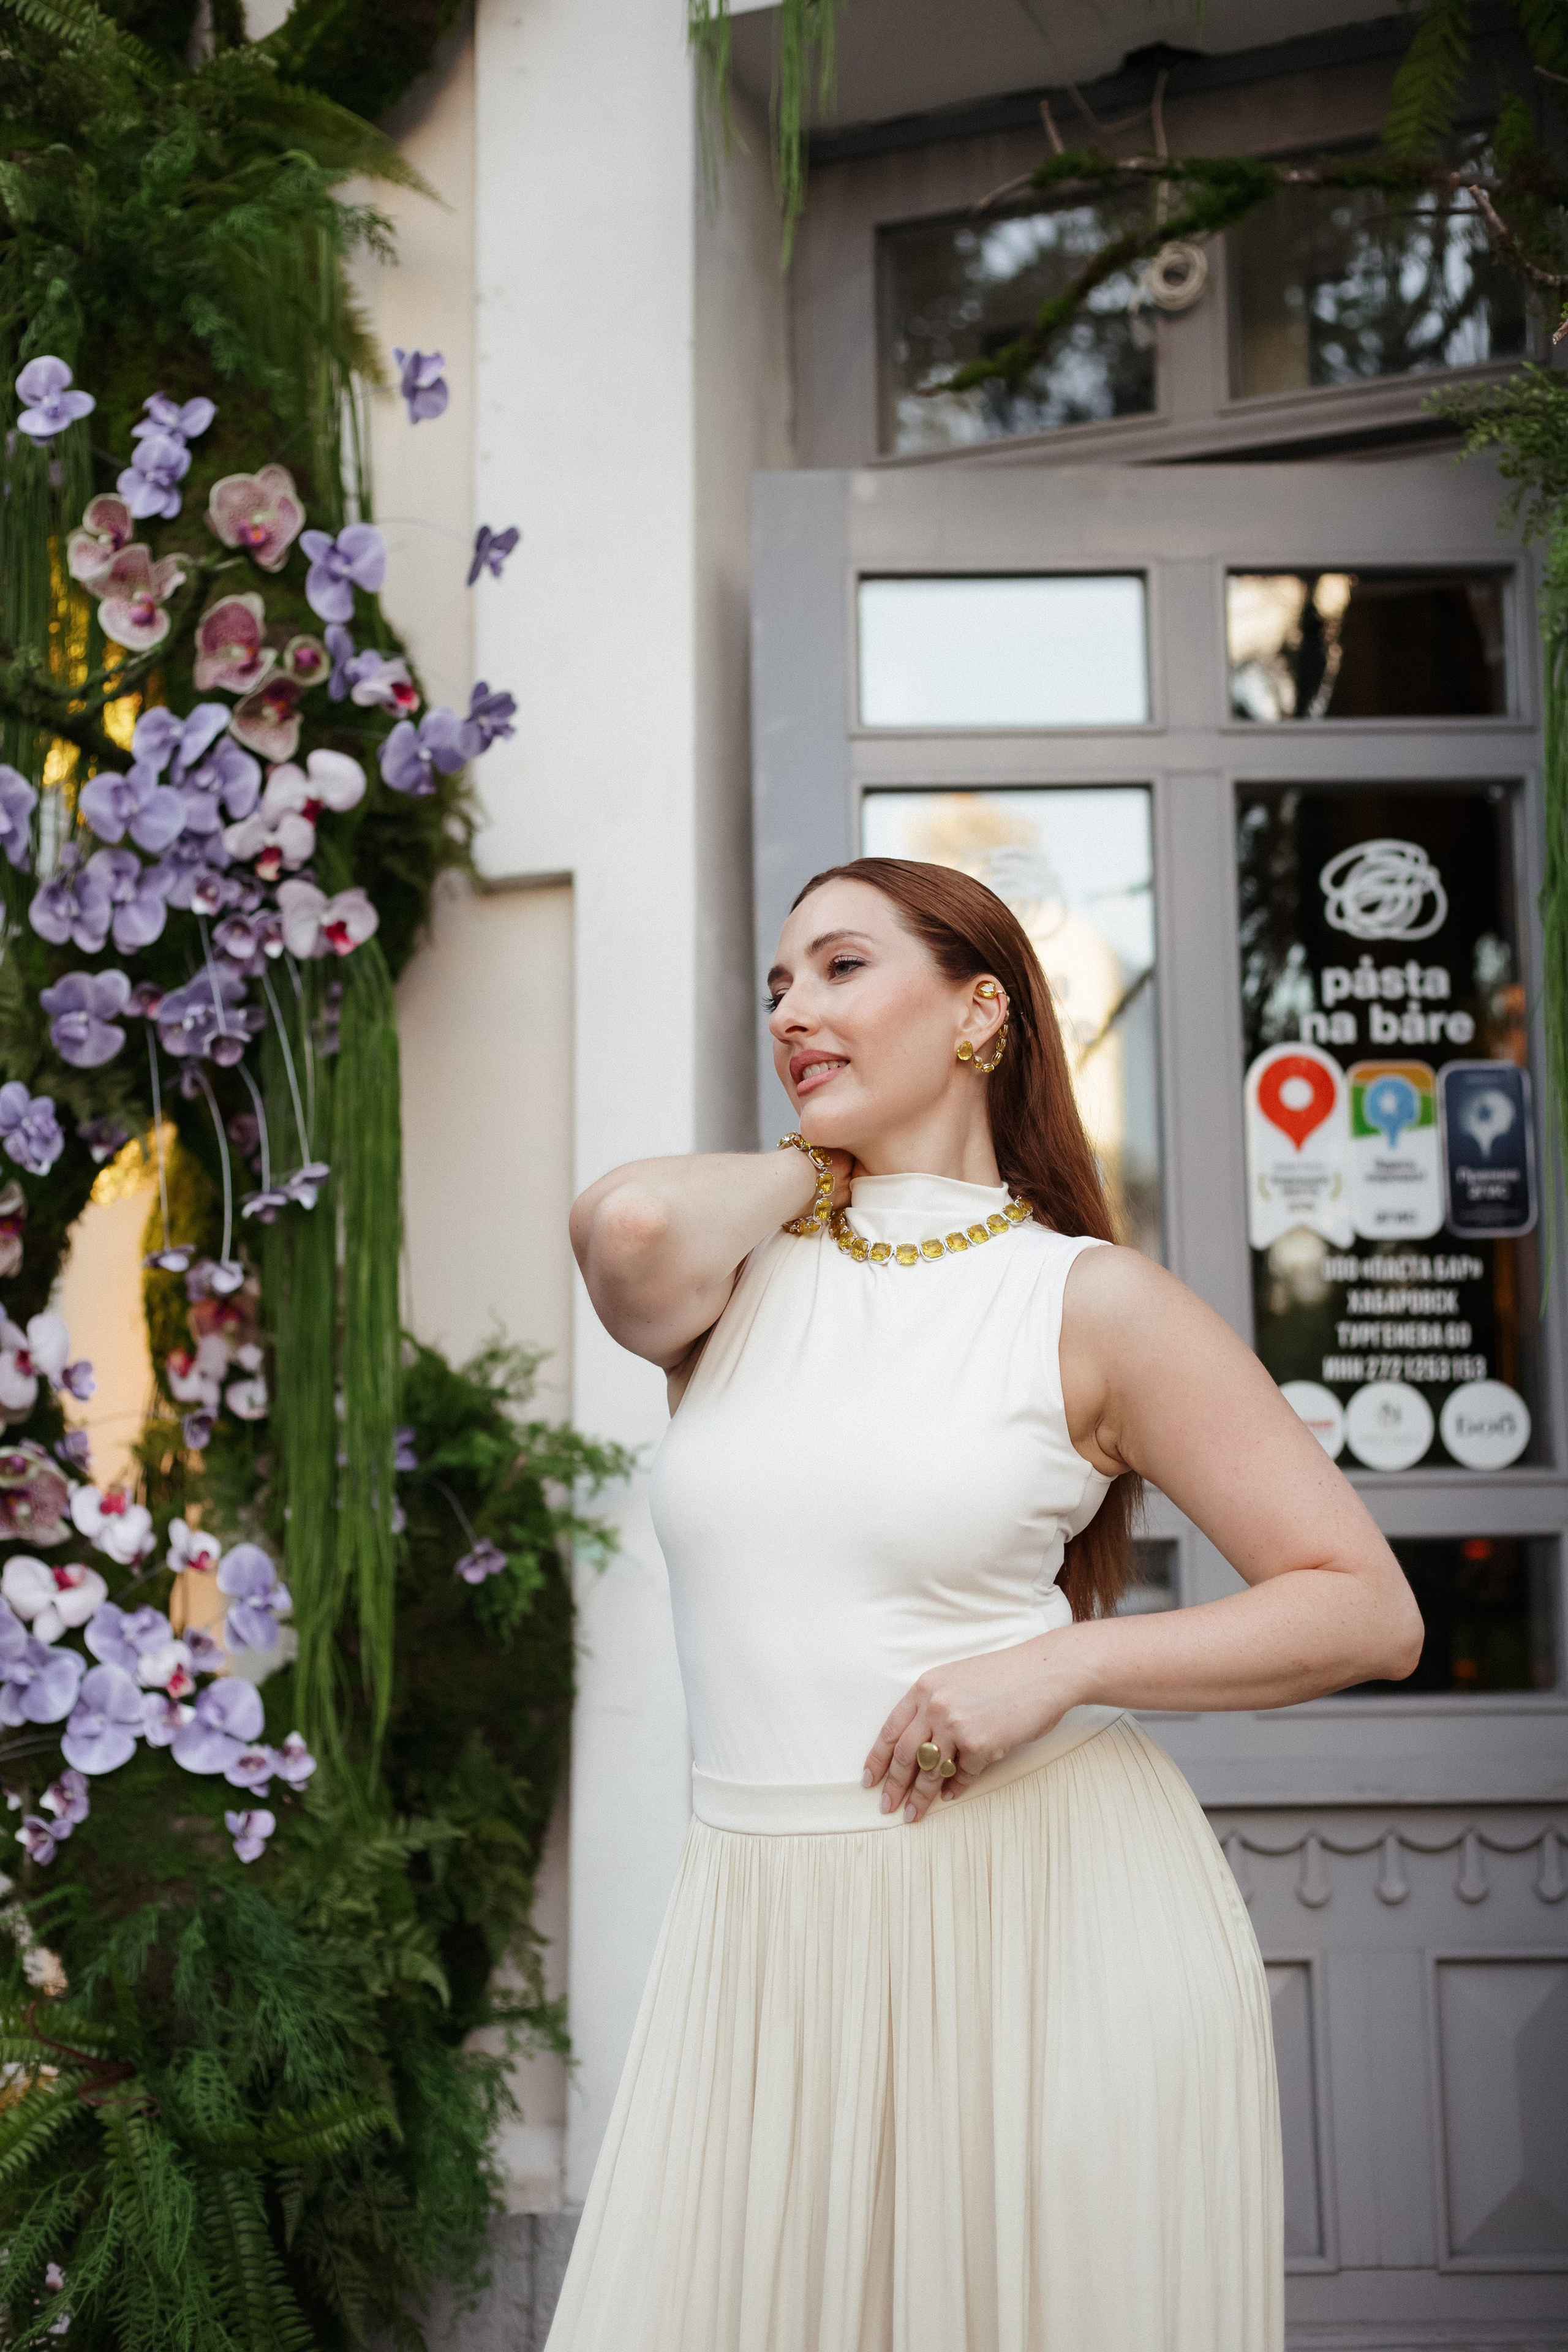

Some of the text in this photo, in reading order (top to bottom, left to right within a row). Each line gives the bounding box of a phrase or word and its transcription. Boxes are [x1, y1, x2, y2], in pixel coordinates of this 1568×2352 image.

[1300, 1011, 1358, 1044] na
[1348, 1289, 1458, 1314] ХАБАРОВСК
[1336, 1322, 1442, 1347] ТУРГЕНЕВА
